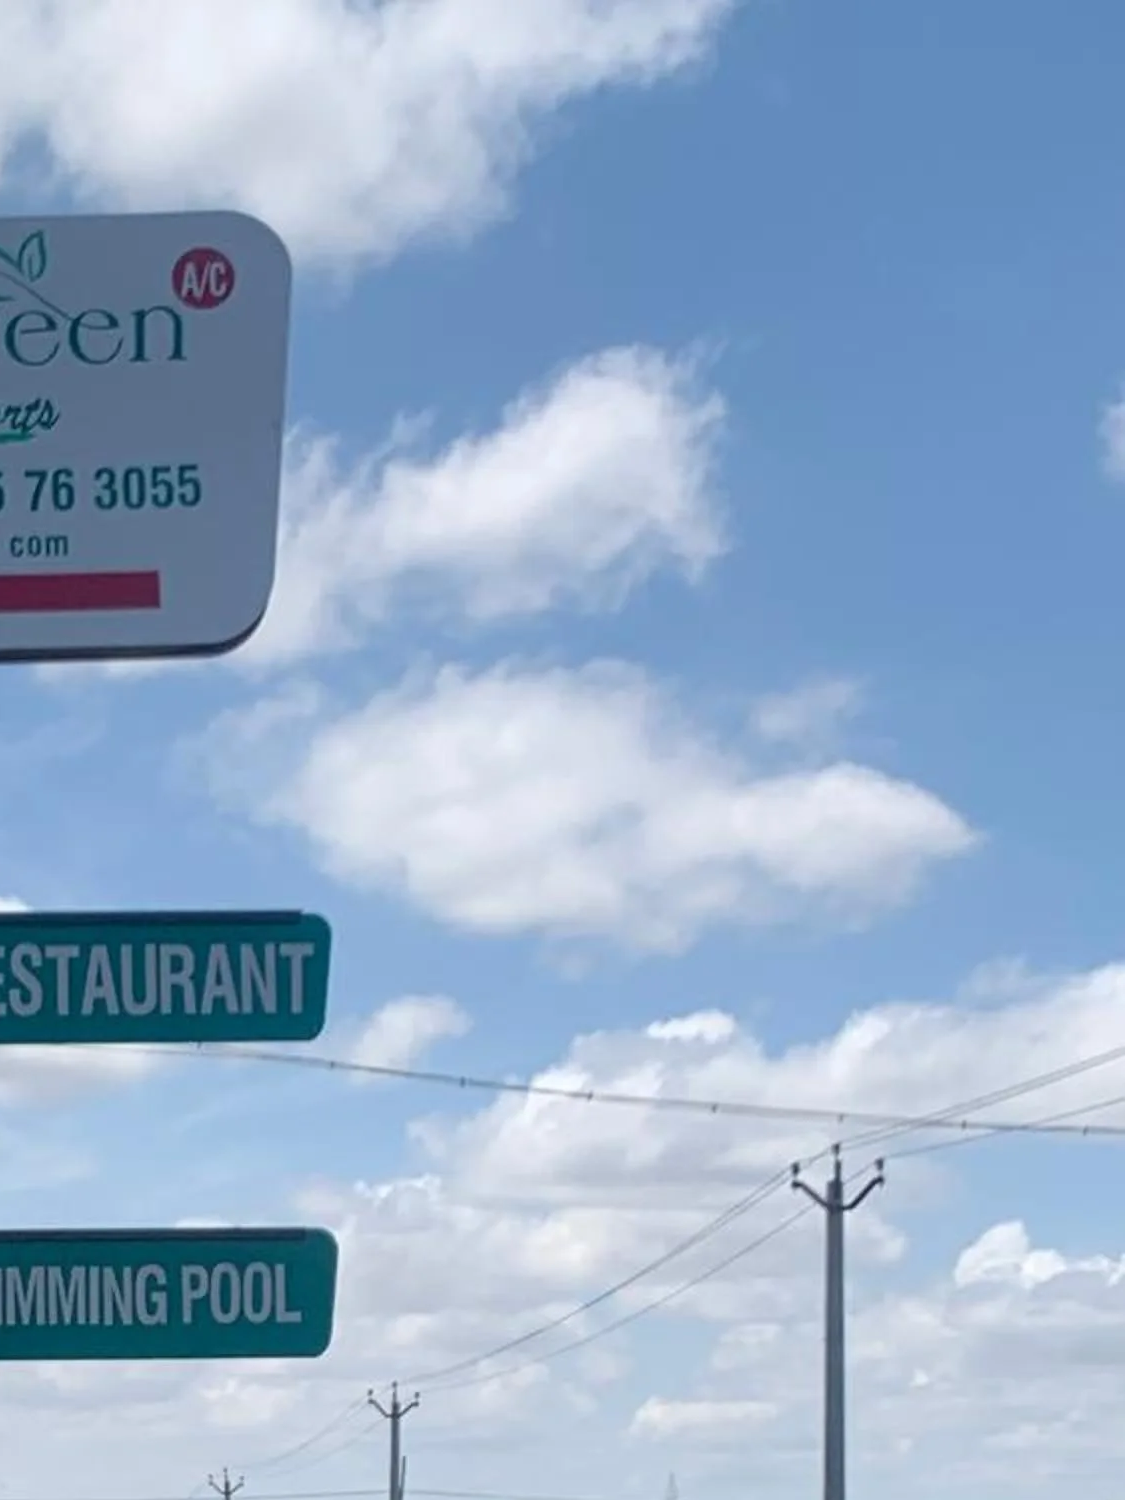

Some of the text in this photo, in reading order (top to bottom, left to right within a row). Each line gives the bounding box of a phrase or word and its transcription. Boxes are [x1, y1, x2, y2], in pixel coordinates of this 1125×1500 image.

[181, 256, 227, 300] A/C
[25, 469, 75, 512] 76
[94, 464, 202, 510] 3055
[181, 1261, 302, 1324] POOL
